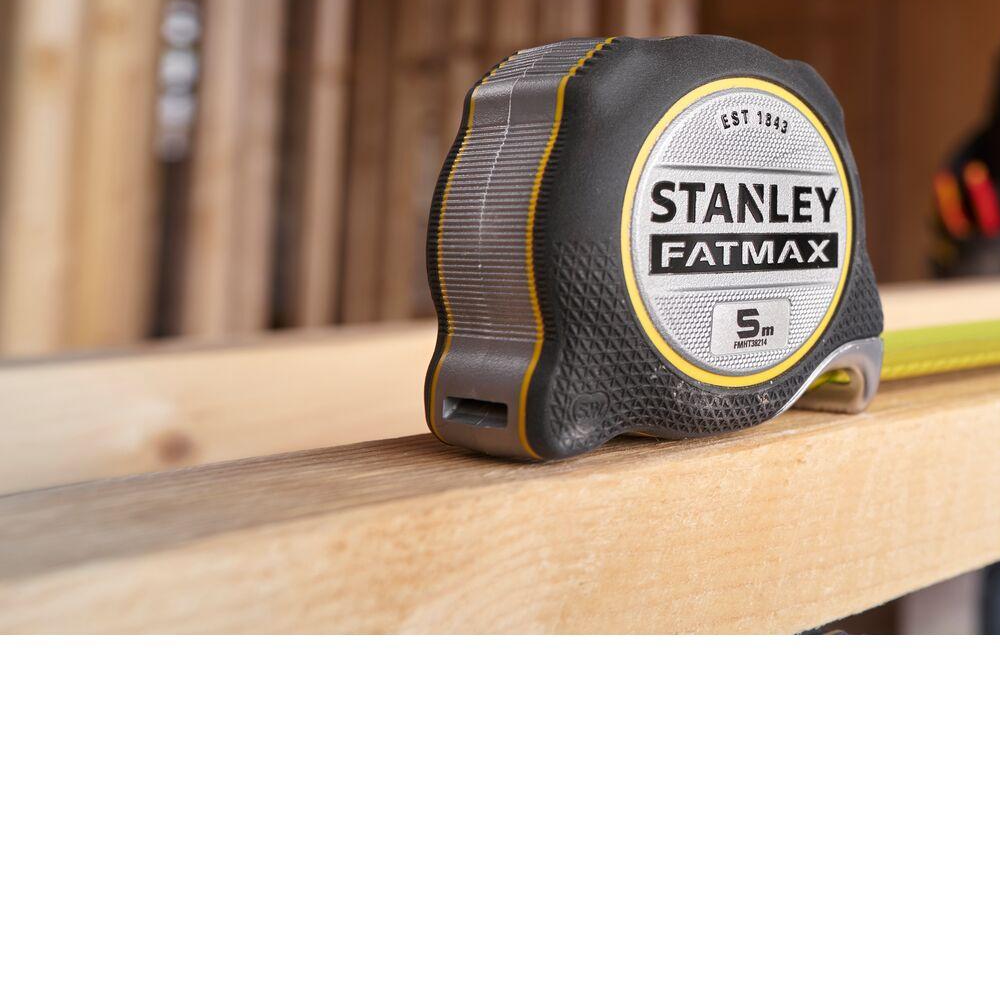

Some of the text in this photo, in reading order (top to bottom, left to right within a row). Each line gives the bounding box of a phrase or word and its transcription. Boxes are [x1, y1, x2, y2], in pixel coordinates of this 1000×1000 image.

[721, 109, 788, 134] EST 1843
[650, 181, 838, 223] STANLEY
[661, 239, 831, 268] FATMAX
